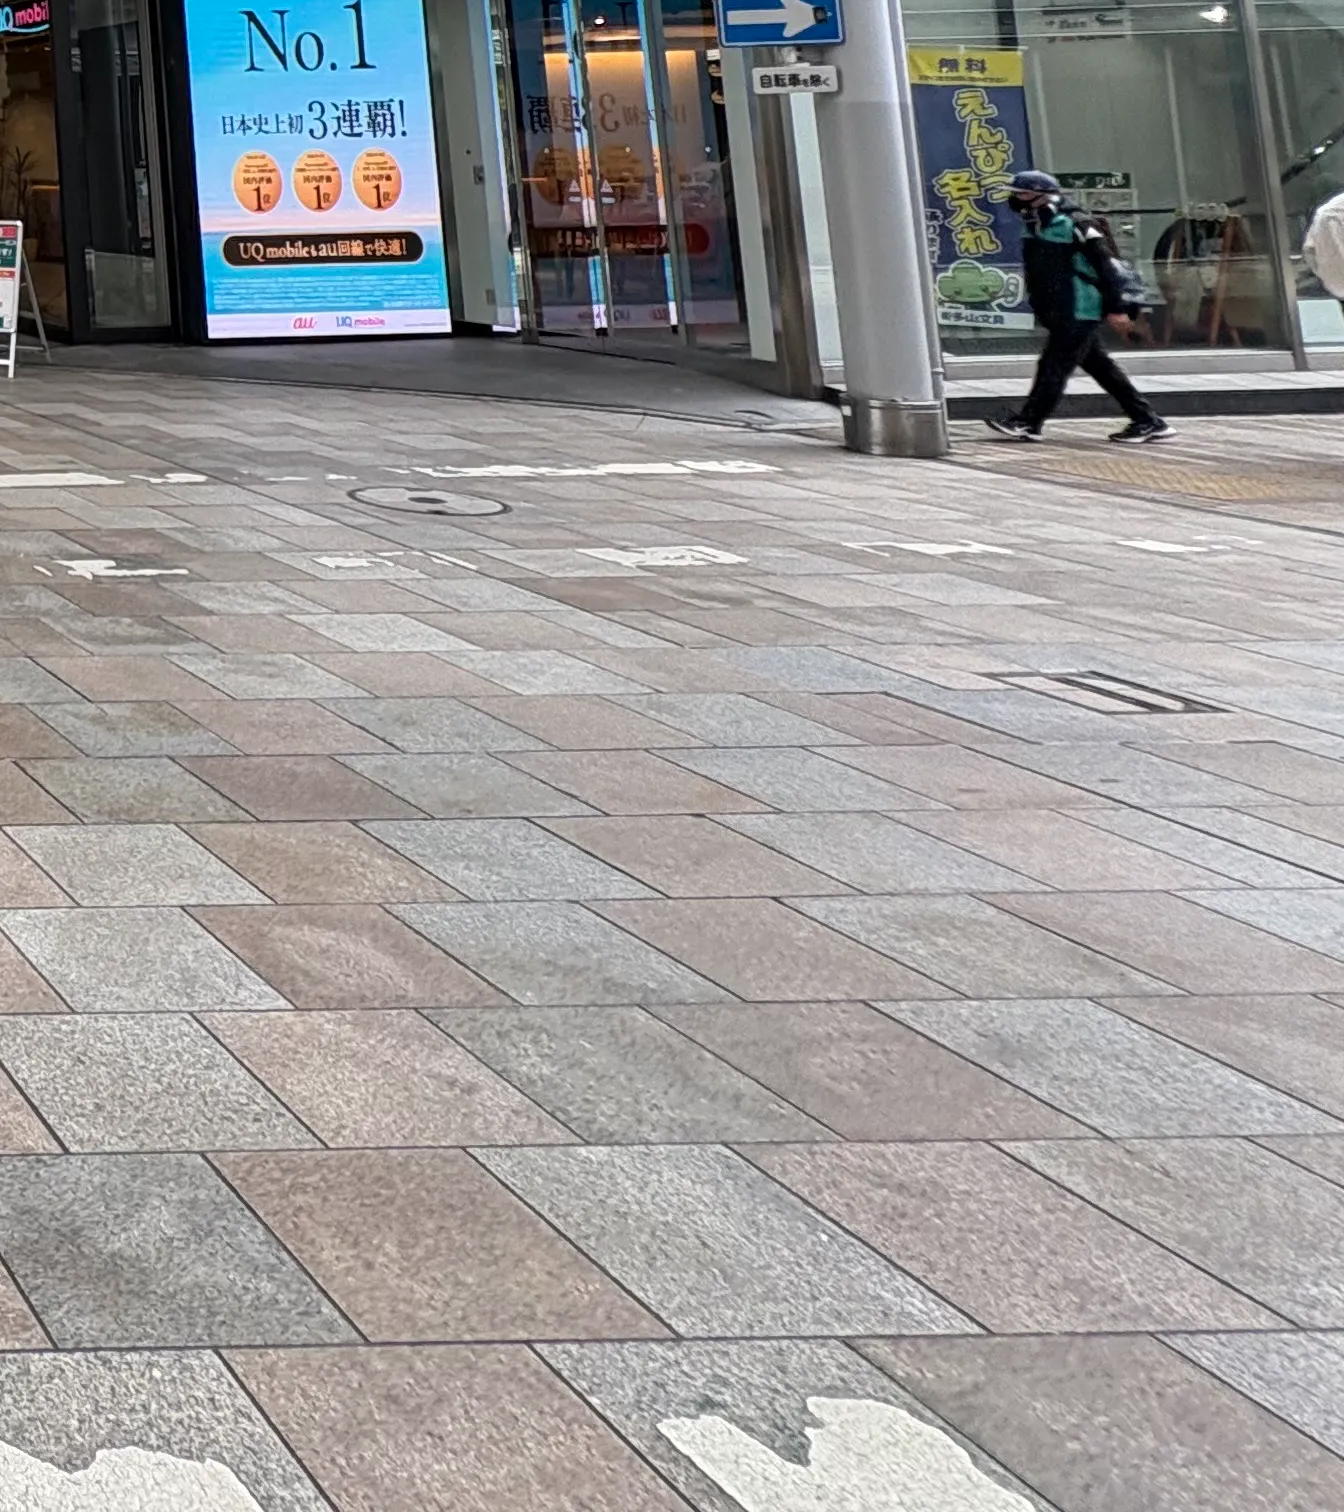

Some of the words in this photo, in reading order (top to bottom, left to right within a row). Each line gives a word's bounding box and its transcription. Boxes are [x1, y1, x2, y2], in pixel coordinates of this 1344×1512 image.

[15, 0, 50, 26] mobil
[239, 0, 377, 72] No.1
[938, 57, 987, 75] 無料
[759, 73, 831, 89] 自転車を除く
[953, 88, 1014, 203] えんぴつ
[253, 187, 271, 212] 1位
[313, 185, 331, 209] 1位
[373, 184, 392, 209] 1位
[933, 169, 1002, 257] 名入れ
[239, 242, 266, 261] UQ
[293, 317, 317, 330] au
[336, 316, 353, 328] UQ
